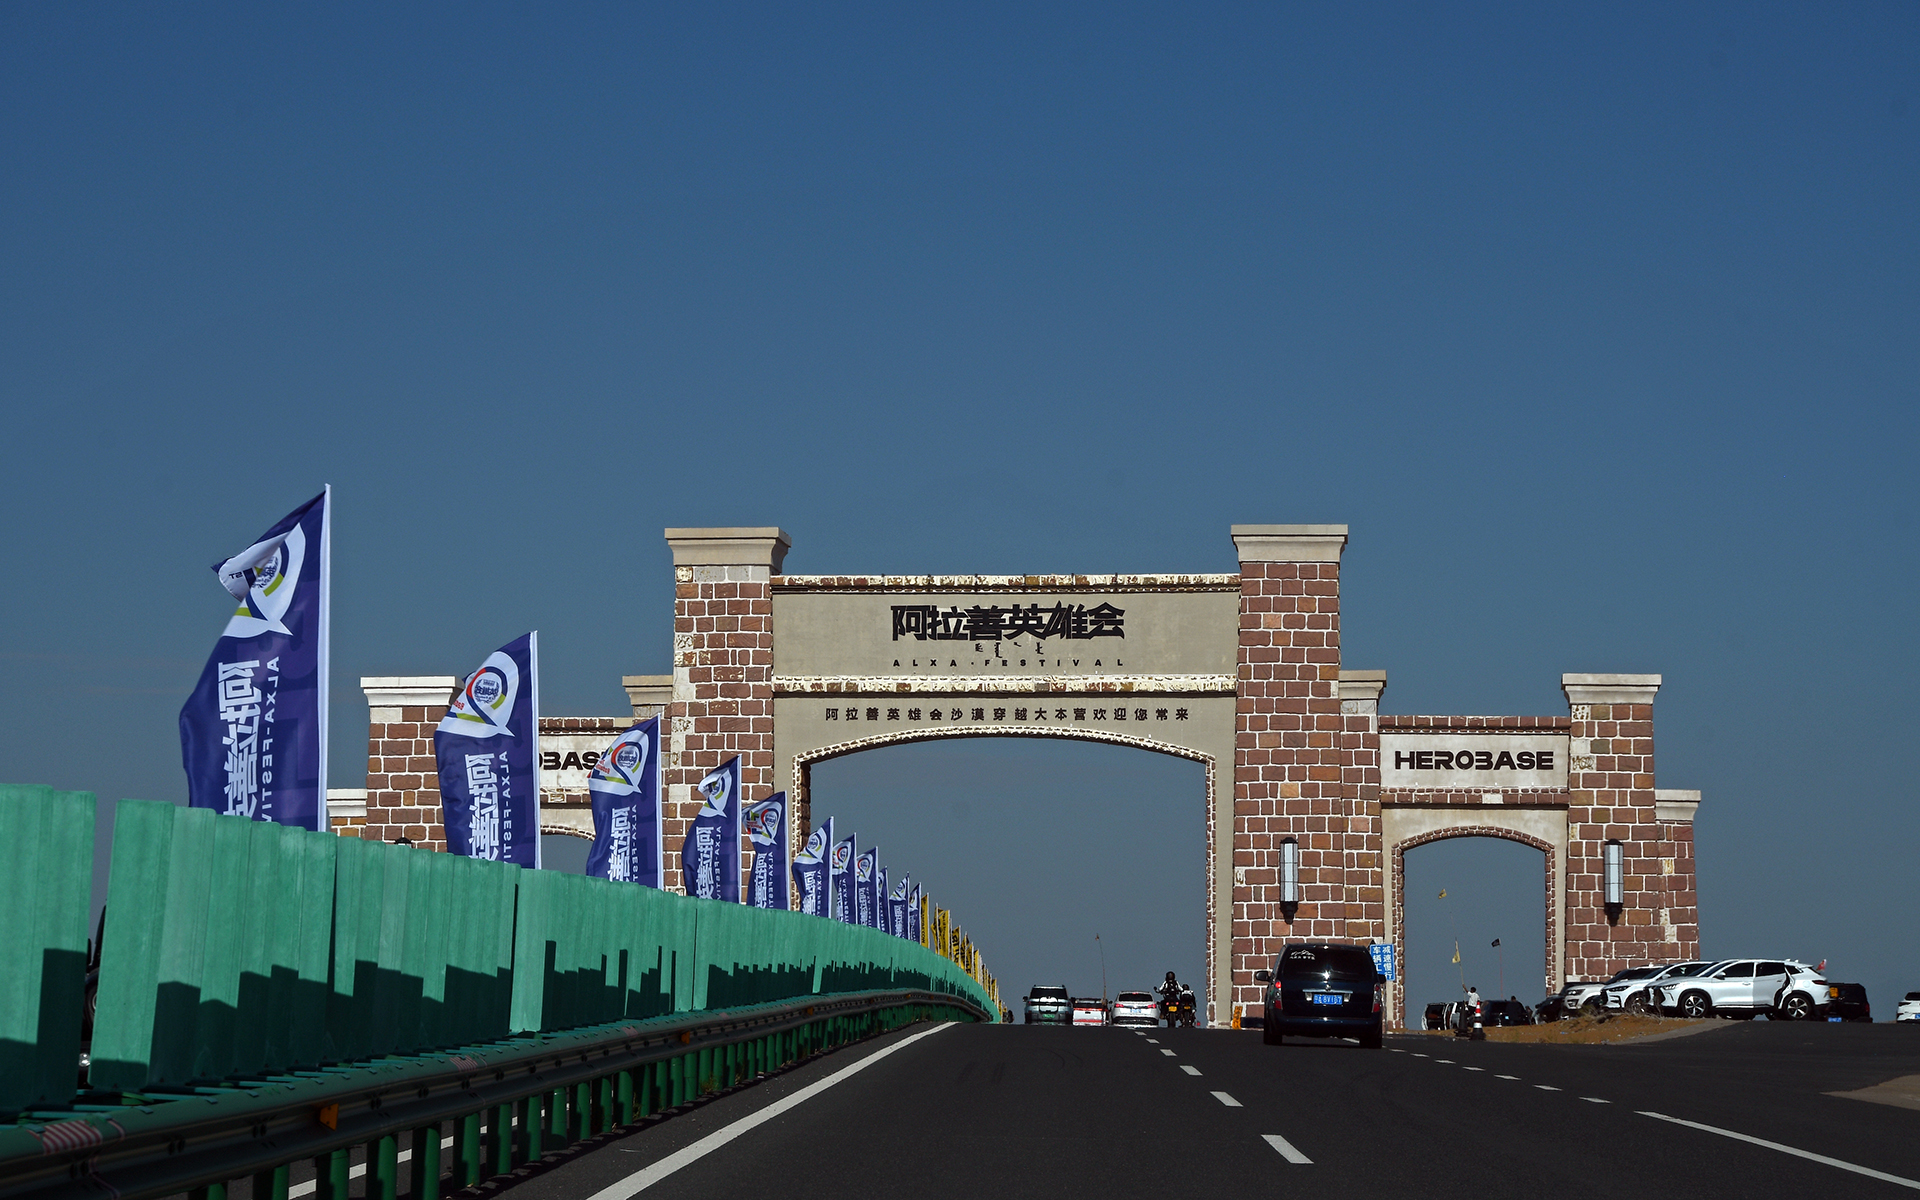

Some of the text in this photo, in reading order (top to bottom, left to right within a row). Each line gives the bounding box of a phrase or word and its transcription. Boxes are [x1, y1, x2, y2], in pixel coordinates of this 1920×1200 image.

[891, 601, 1125, 641] 阿拉善英雄会
[539, 751, 605, 770] BAS
[1395, 750, 1554, 771] HEROBASE
